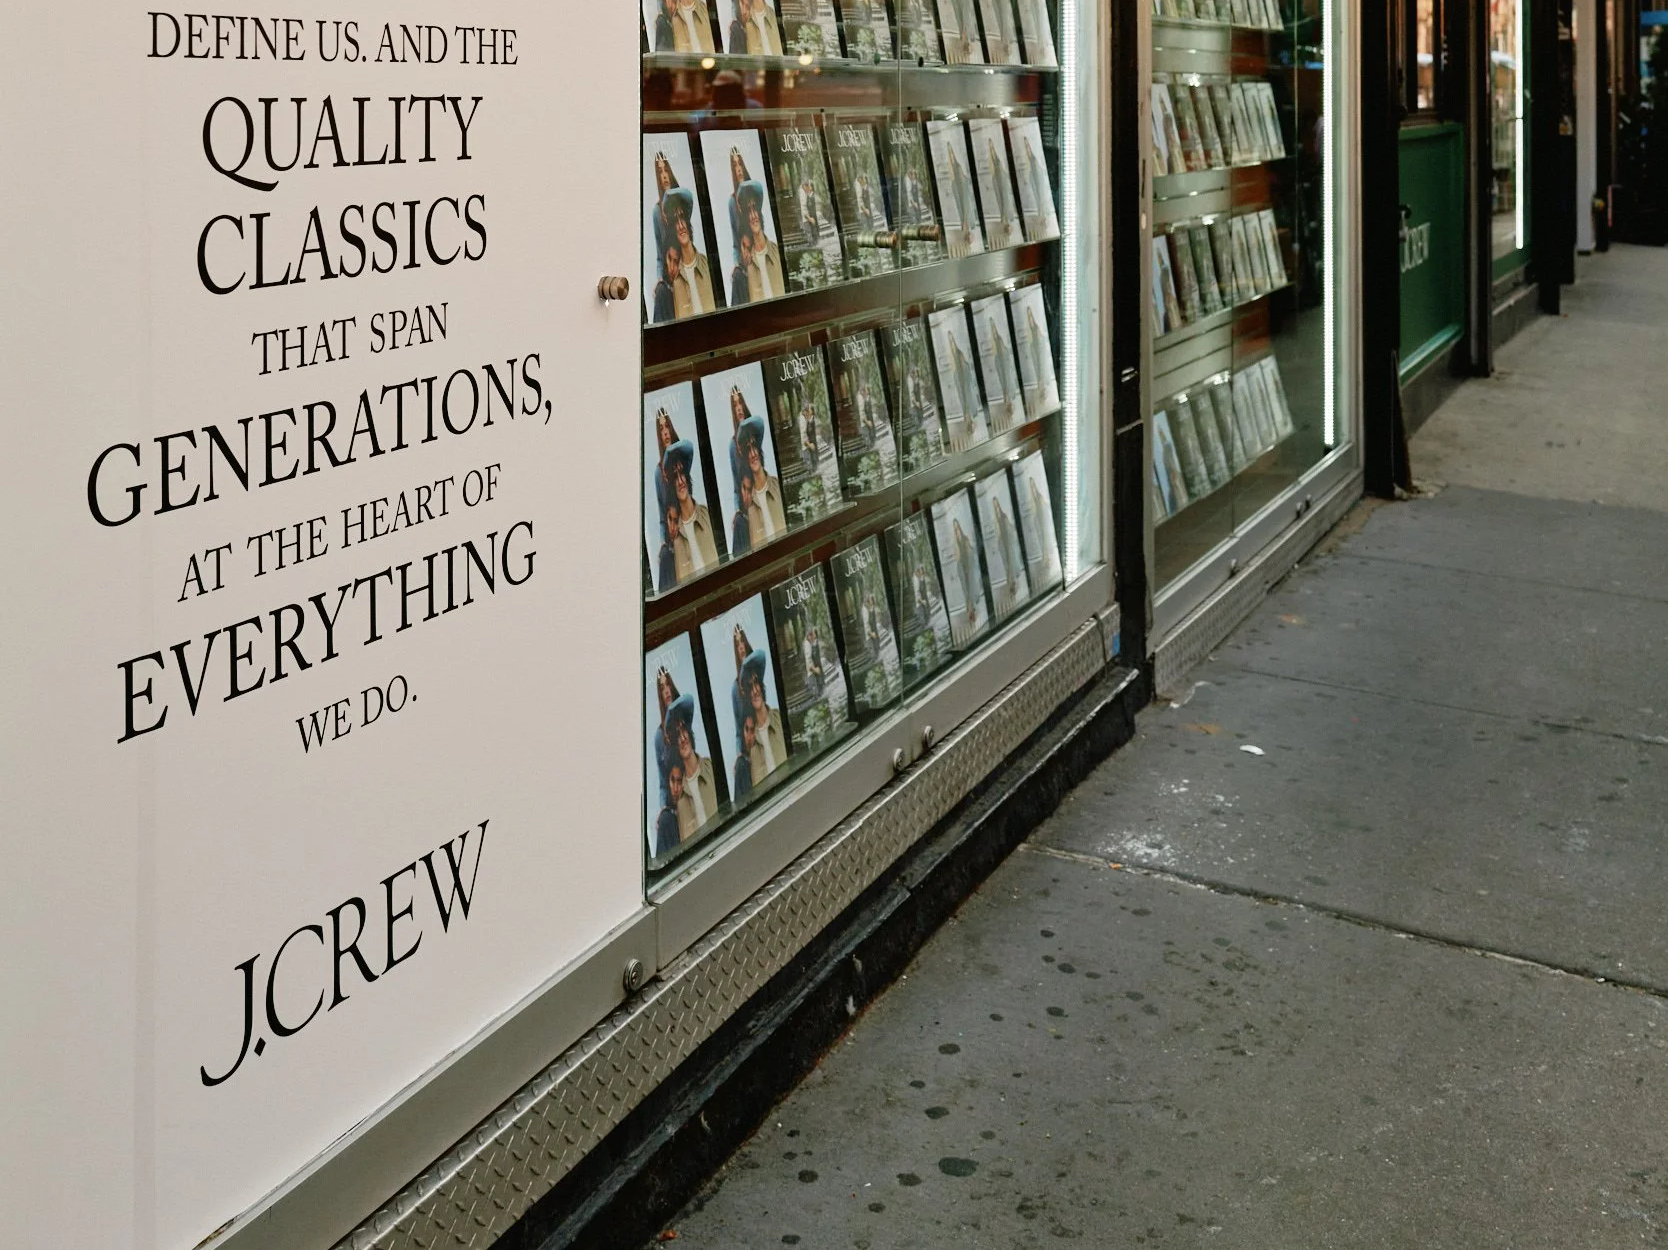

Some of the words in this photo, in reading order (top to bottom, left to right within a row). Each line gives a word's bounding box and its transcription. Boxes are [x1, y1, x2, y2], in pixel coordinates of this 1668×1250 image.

[146, 11, 306, 61] DEFINE
[315, 20, 367, 63] US.
[374, 22, 448, 64] AND
[454, 25, 519, 66] THE
[202, 93, 484, 192] QUALITY
[196, 193, 487, 296] CLASSICS
[251, 315, 357, 376] THAT
[370, 301, 449, 354] SPAN
[780, 353, 816, 382] J.CREW
[87, 352, 552, 528] GENERATIONS,
[177, 542, 233, 603] AT
[246, 515, 329, 578] THE
[340, 475, 455, 550] HEART
[462, 462, 502, 507] OF
[116, 520, 537, 745] EVERYTHING
[784, 574, 817, 610] J.CREW
[295, 697, 352, 754] WE
[360, 674, 418, 728] DO.
[199, 818, 490, 1087] J.CREW
